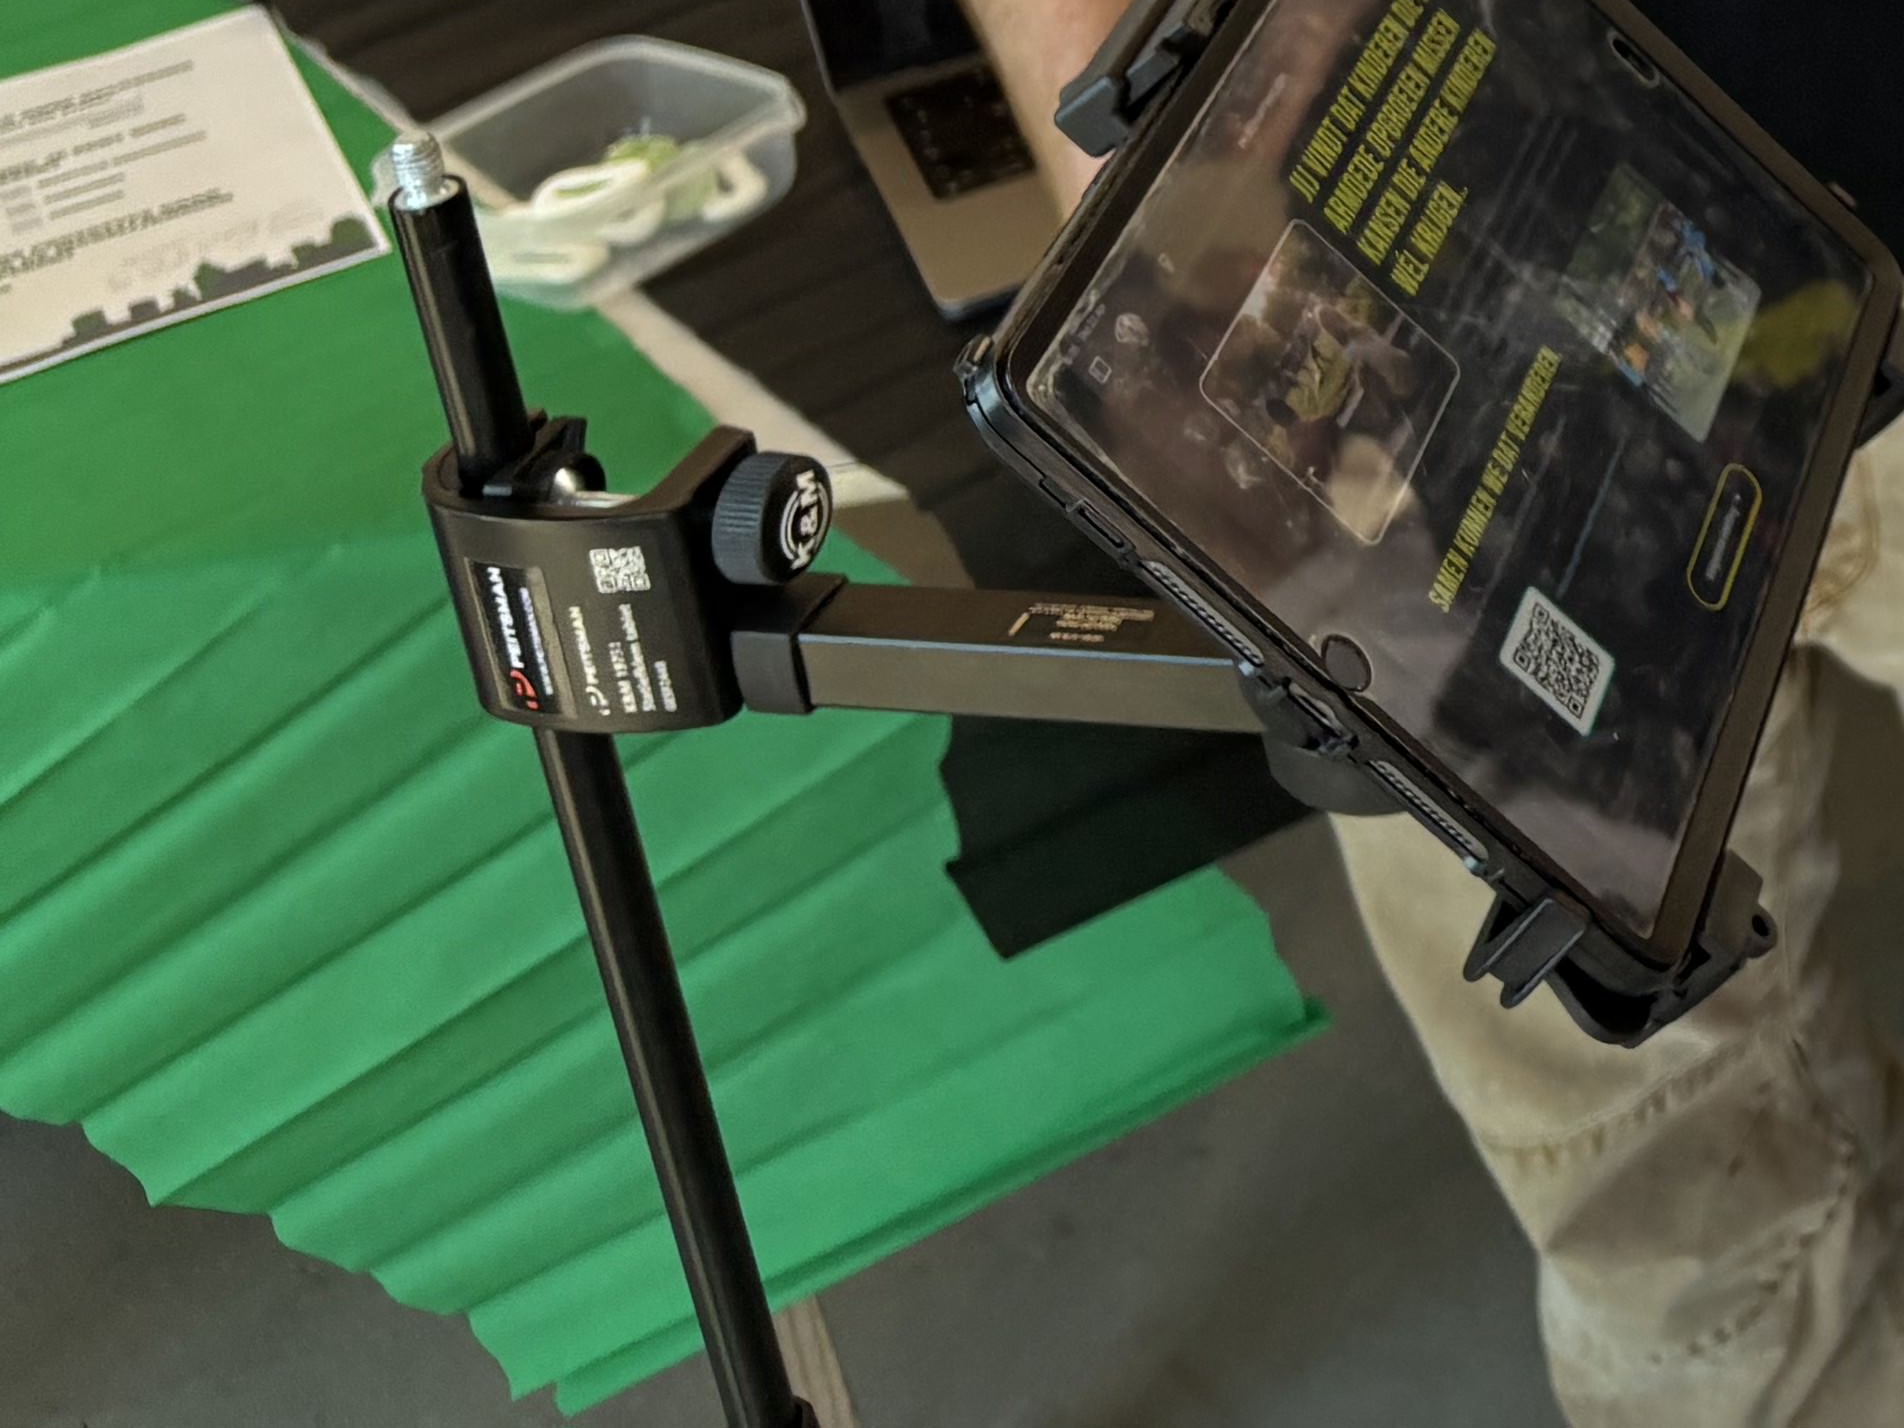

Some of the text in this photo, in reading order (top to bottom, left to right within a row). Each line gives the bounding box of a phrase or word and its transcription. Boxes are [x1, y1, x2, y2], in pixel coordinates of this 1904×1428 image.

[1301, 115, 1348, 179] VINDT
[1330, 85, 1366, 133] DAT
[1391, 156, 1427, 200] DIE
[1408, 96, 1459, 173] ANDERE
[1323, 143, 1385, 236] ARMOEDE
[1356, 185, 1412, 266] KANSEN
[791, 469, 818, 571] K&M
[1428, 547, 1470, 614] SAMEN
[1453, 485, 1497, 559] KUNNEN
[1491, 430, 1521, 473] DAT
[486, 566, 525, 670] PEITSMAN
[568, 605, 600, 685] PEITSMAN
